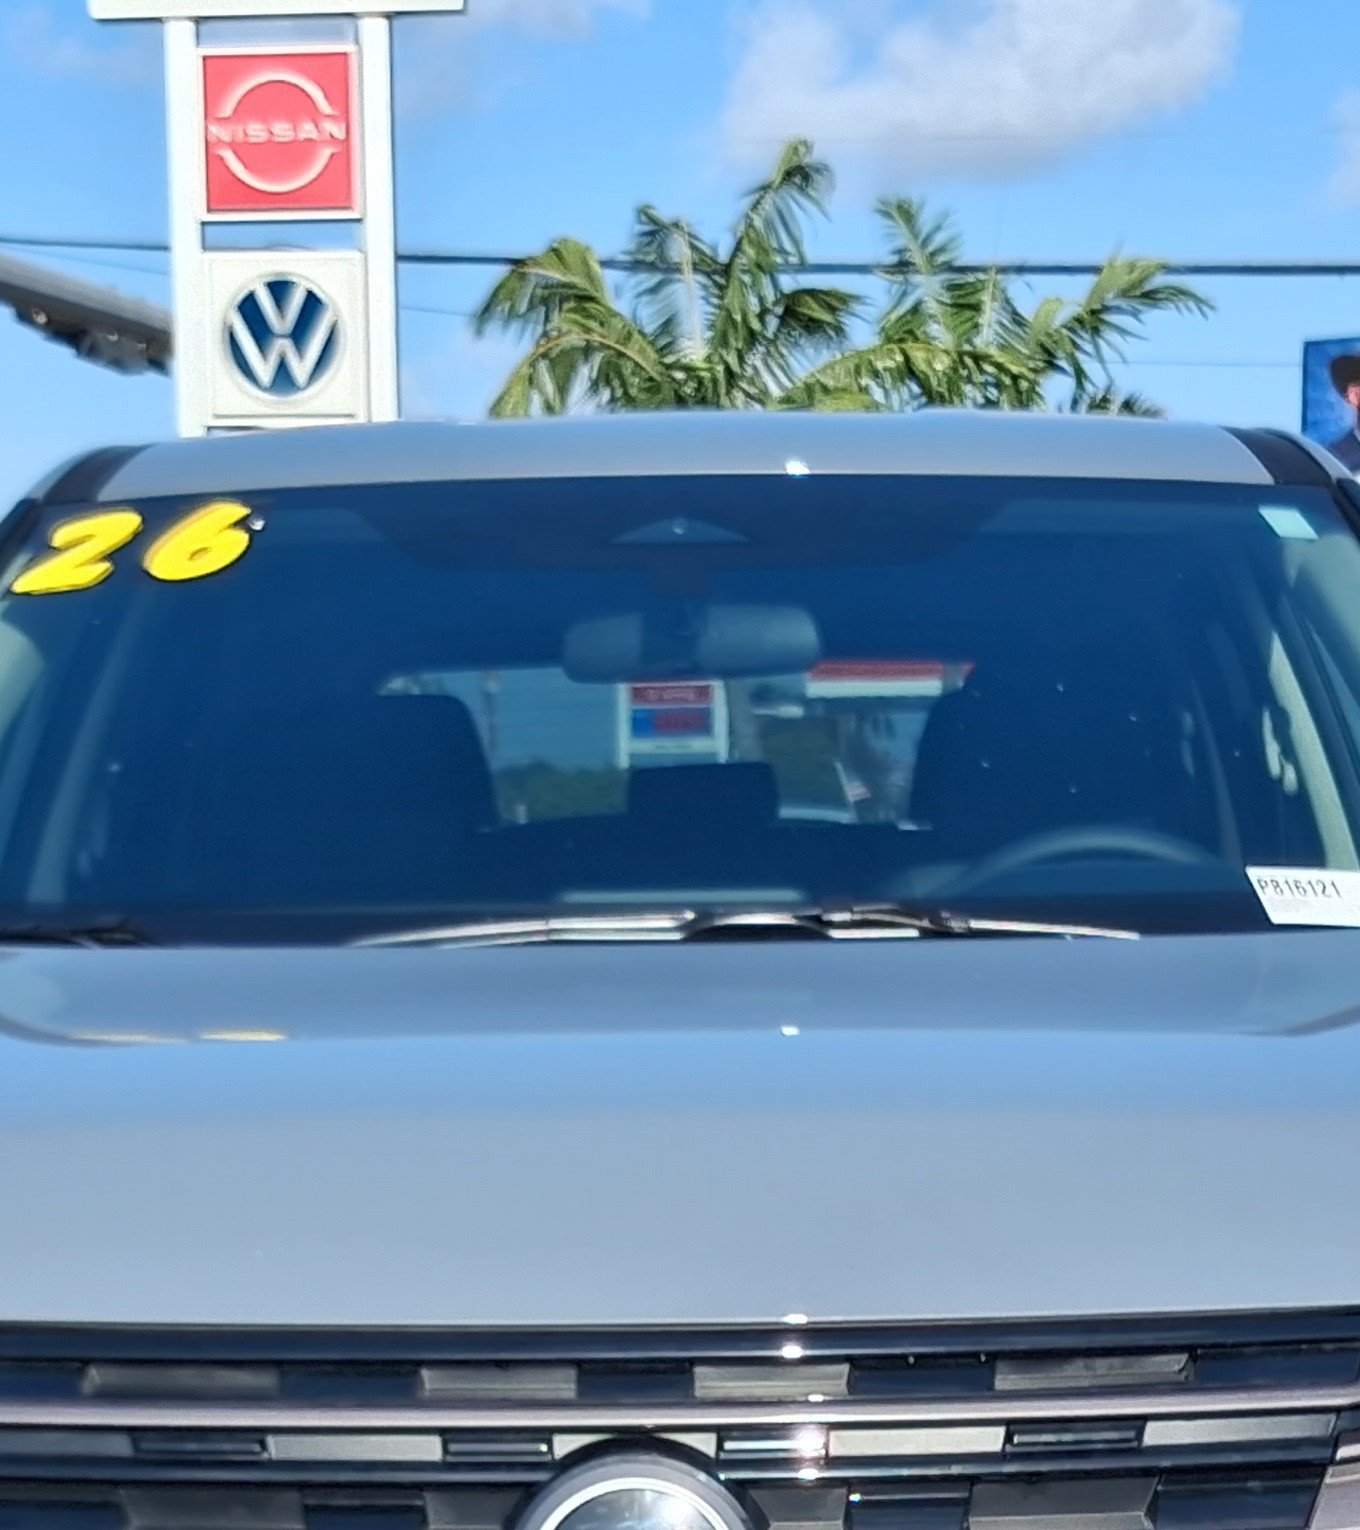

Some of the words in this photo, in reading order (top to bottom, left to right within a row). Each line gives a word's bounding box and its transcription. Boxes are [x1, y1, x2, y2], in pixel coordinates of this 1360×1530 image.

[206, 120, 347, 144] NISSAN
[10, 499, 252, 595] 26
[1255, 877, 1343, 899] P816121
